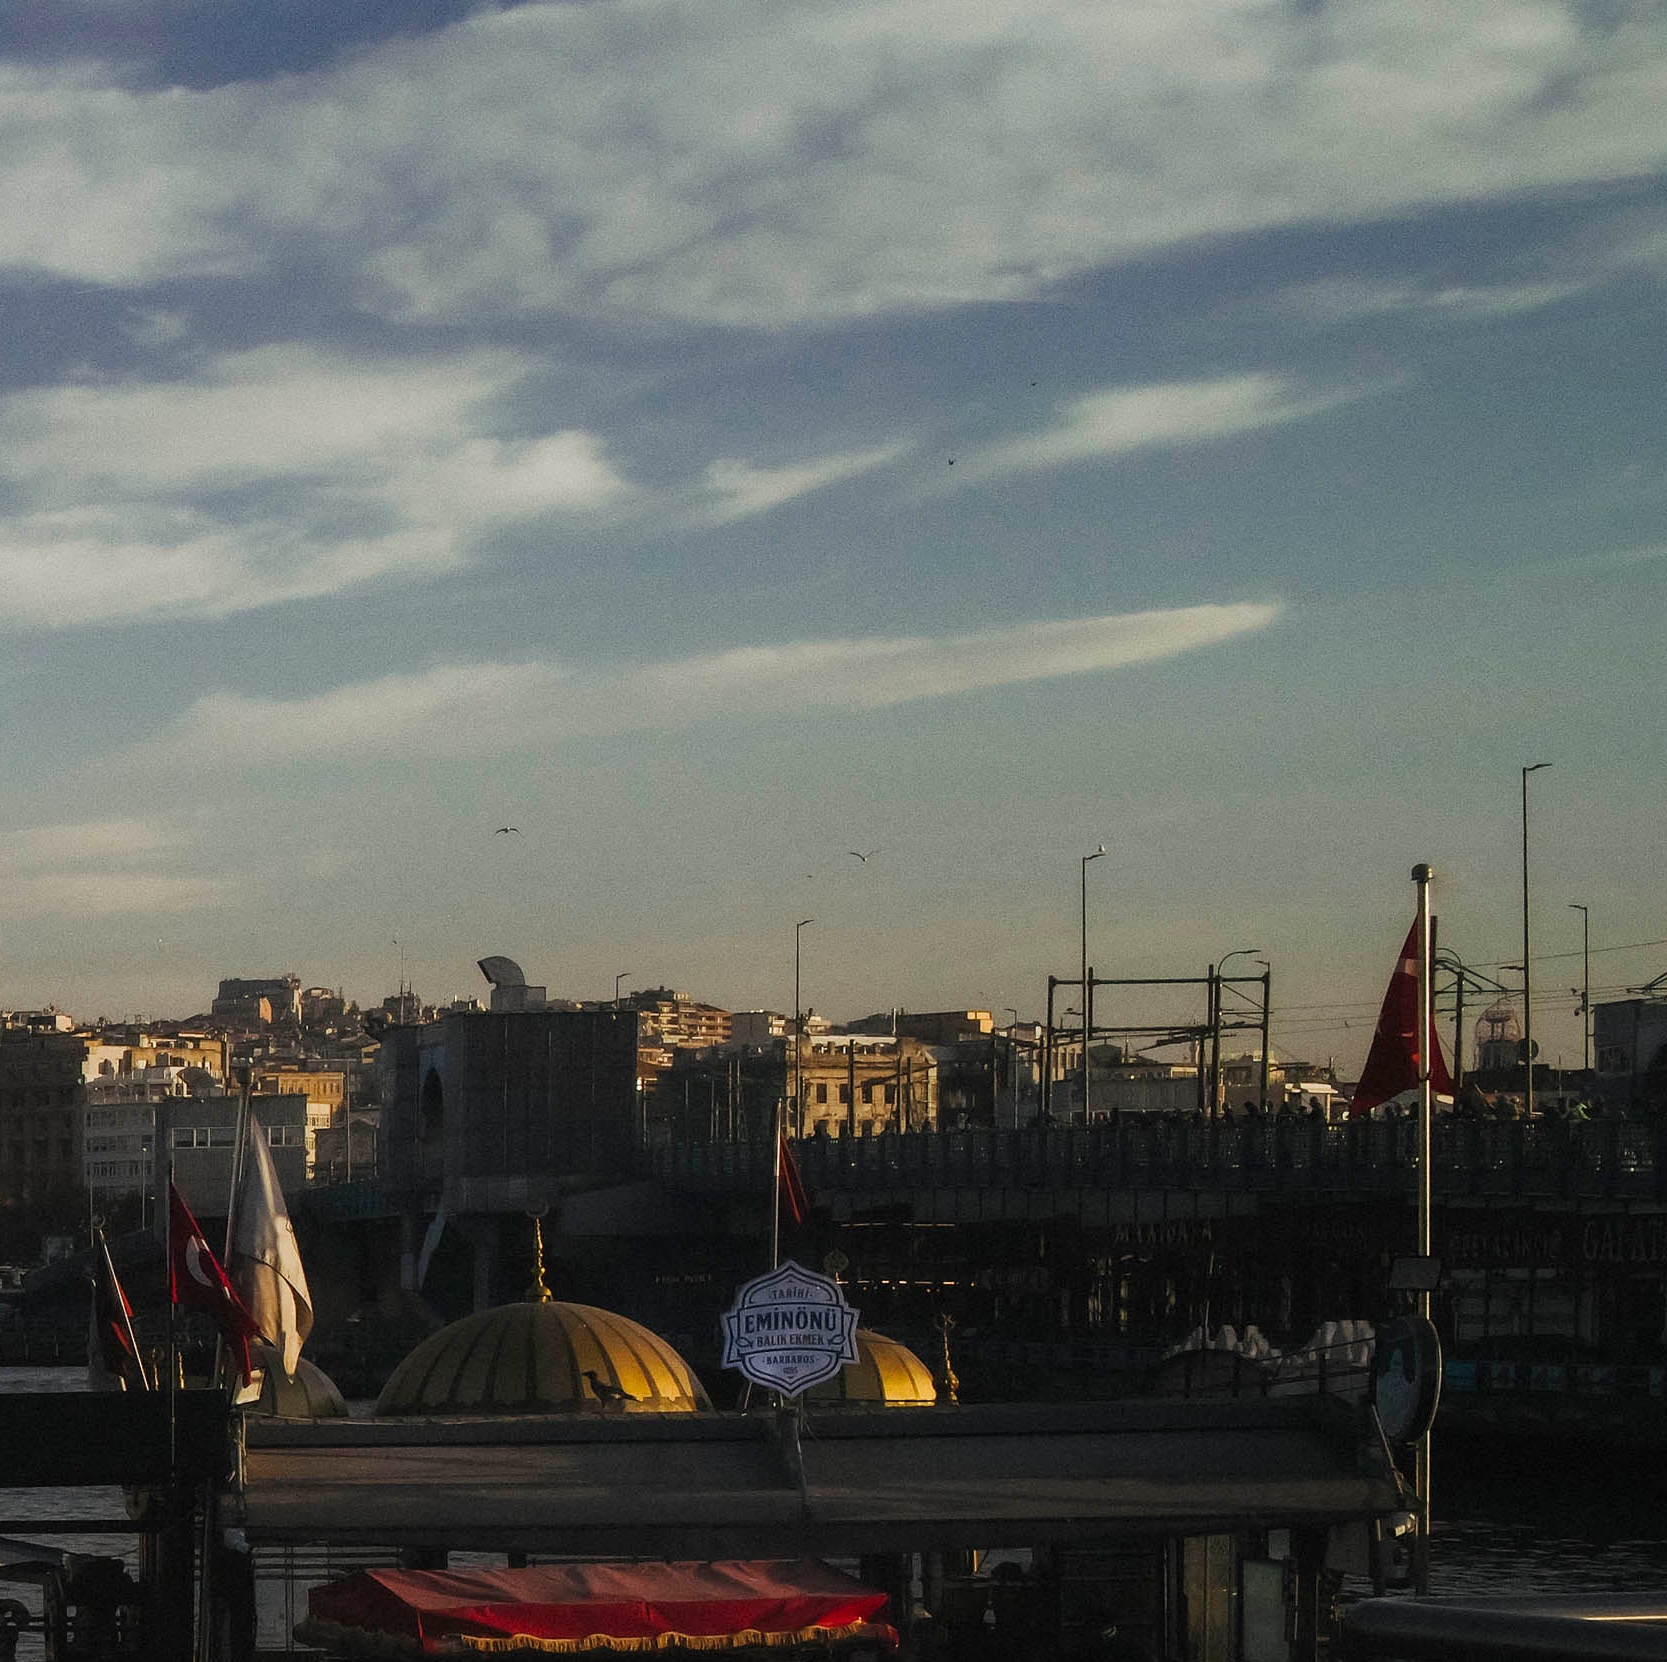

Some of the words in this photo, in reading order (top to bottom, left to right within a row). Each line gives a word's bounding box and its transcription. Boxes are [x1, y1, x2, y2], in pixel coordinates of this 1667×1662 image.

[1582, 1218, 1667, 1262] GALAT
[744, 1306, 837, 1334] EMİNÖNÜ
[756, 1334, 787, 1348] BALIK
[789, 1333, 825, 1346] EKMEK
[766, 1355, 816, 1365] BARBAROS
